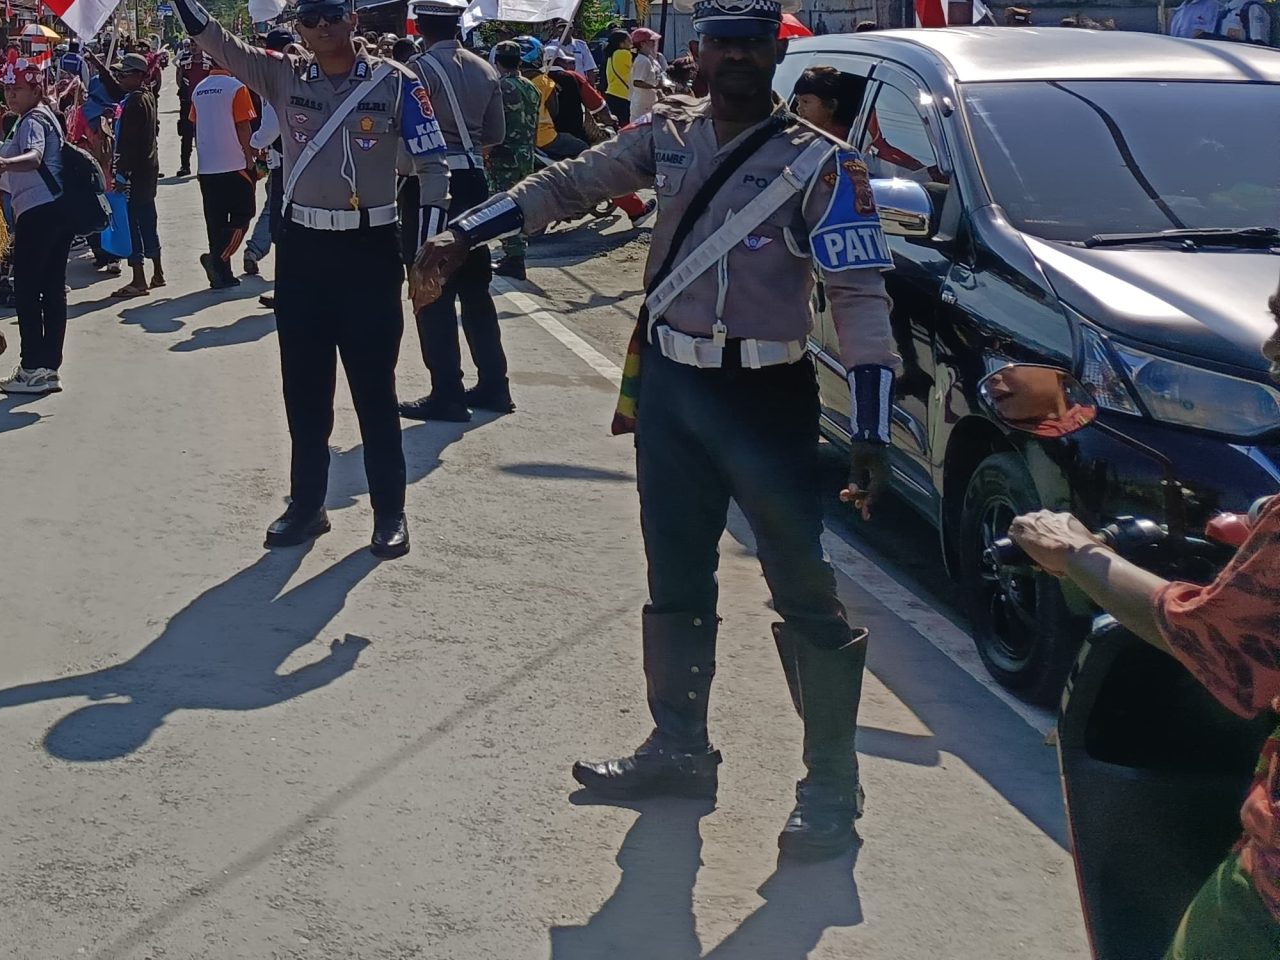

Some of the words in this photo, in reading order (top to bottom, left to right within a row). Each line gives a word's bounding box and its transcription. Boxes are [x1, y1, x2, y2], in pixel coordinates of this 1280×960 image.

[357, 102, 386, 113] OLRI
[407, 130, 447, 155] KAM
[823, 227, 892, 266] PATW
